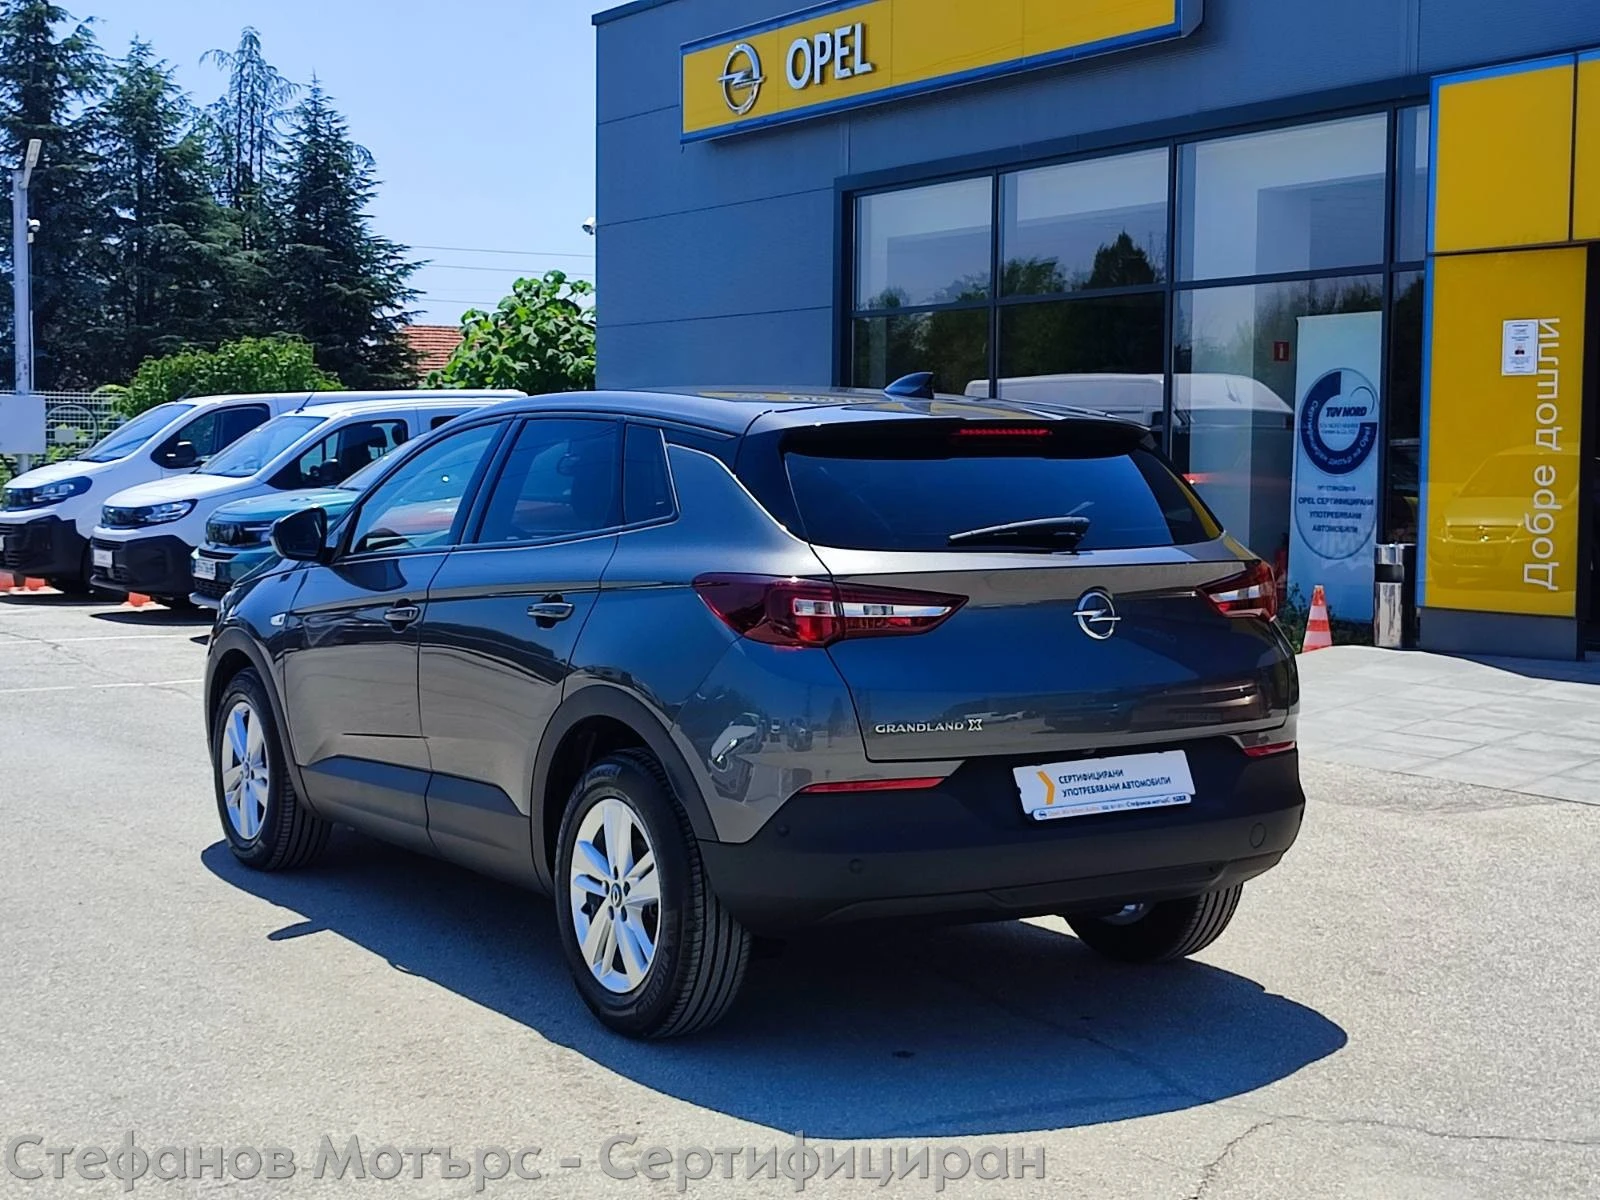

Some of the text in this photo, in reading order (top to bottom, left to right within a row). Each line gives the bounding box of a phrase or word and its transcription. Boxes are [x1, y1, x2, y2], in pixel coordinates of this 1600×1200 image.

[785, 22, 873, 90] OPEL
[1343, 406, 1367, 417] NORD
[1523, 317, 1563, 591] Добре дошли
[875, 718, 983, 734] GRANDLAND X
[1058, 769, 1124, 785] СЕРТИФИЦИРАНИ
[1062, 776, 1171, 798] УПОТРЕБЯВАНИ АВТОМОБИЛИ
